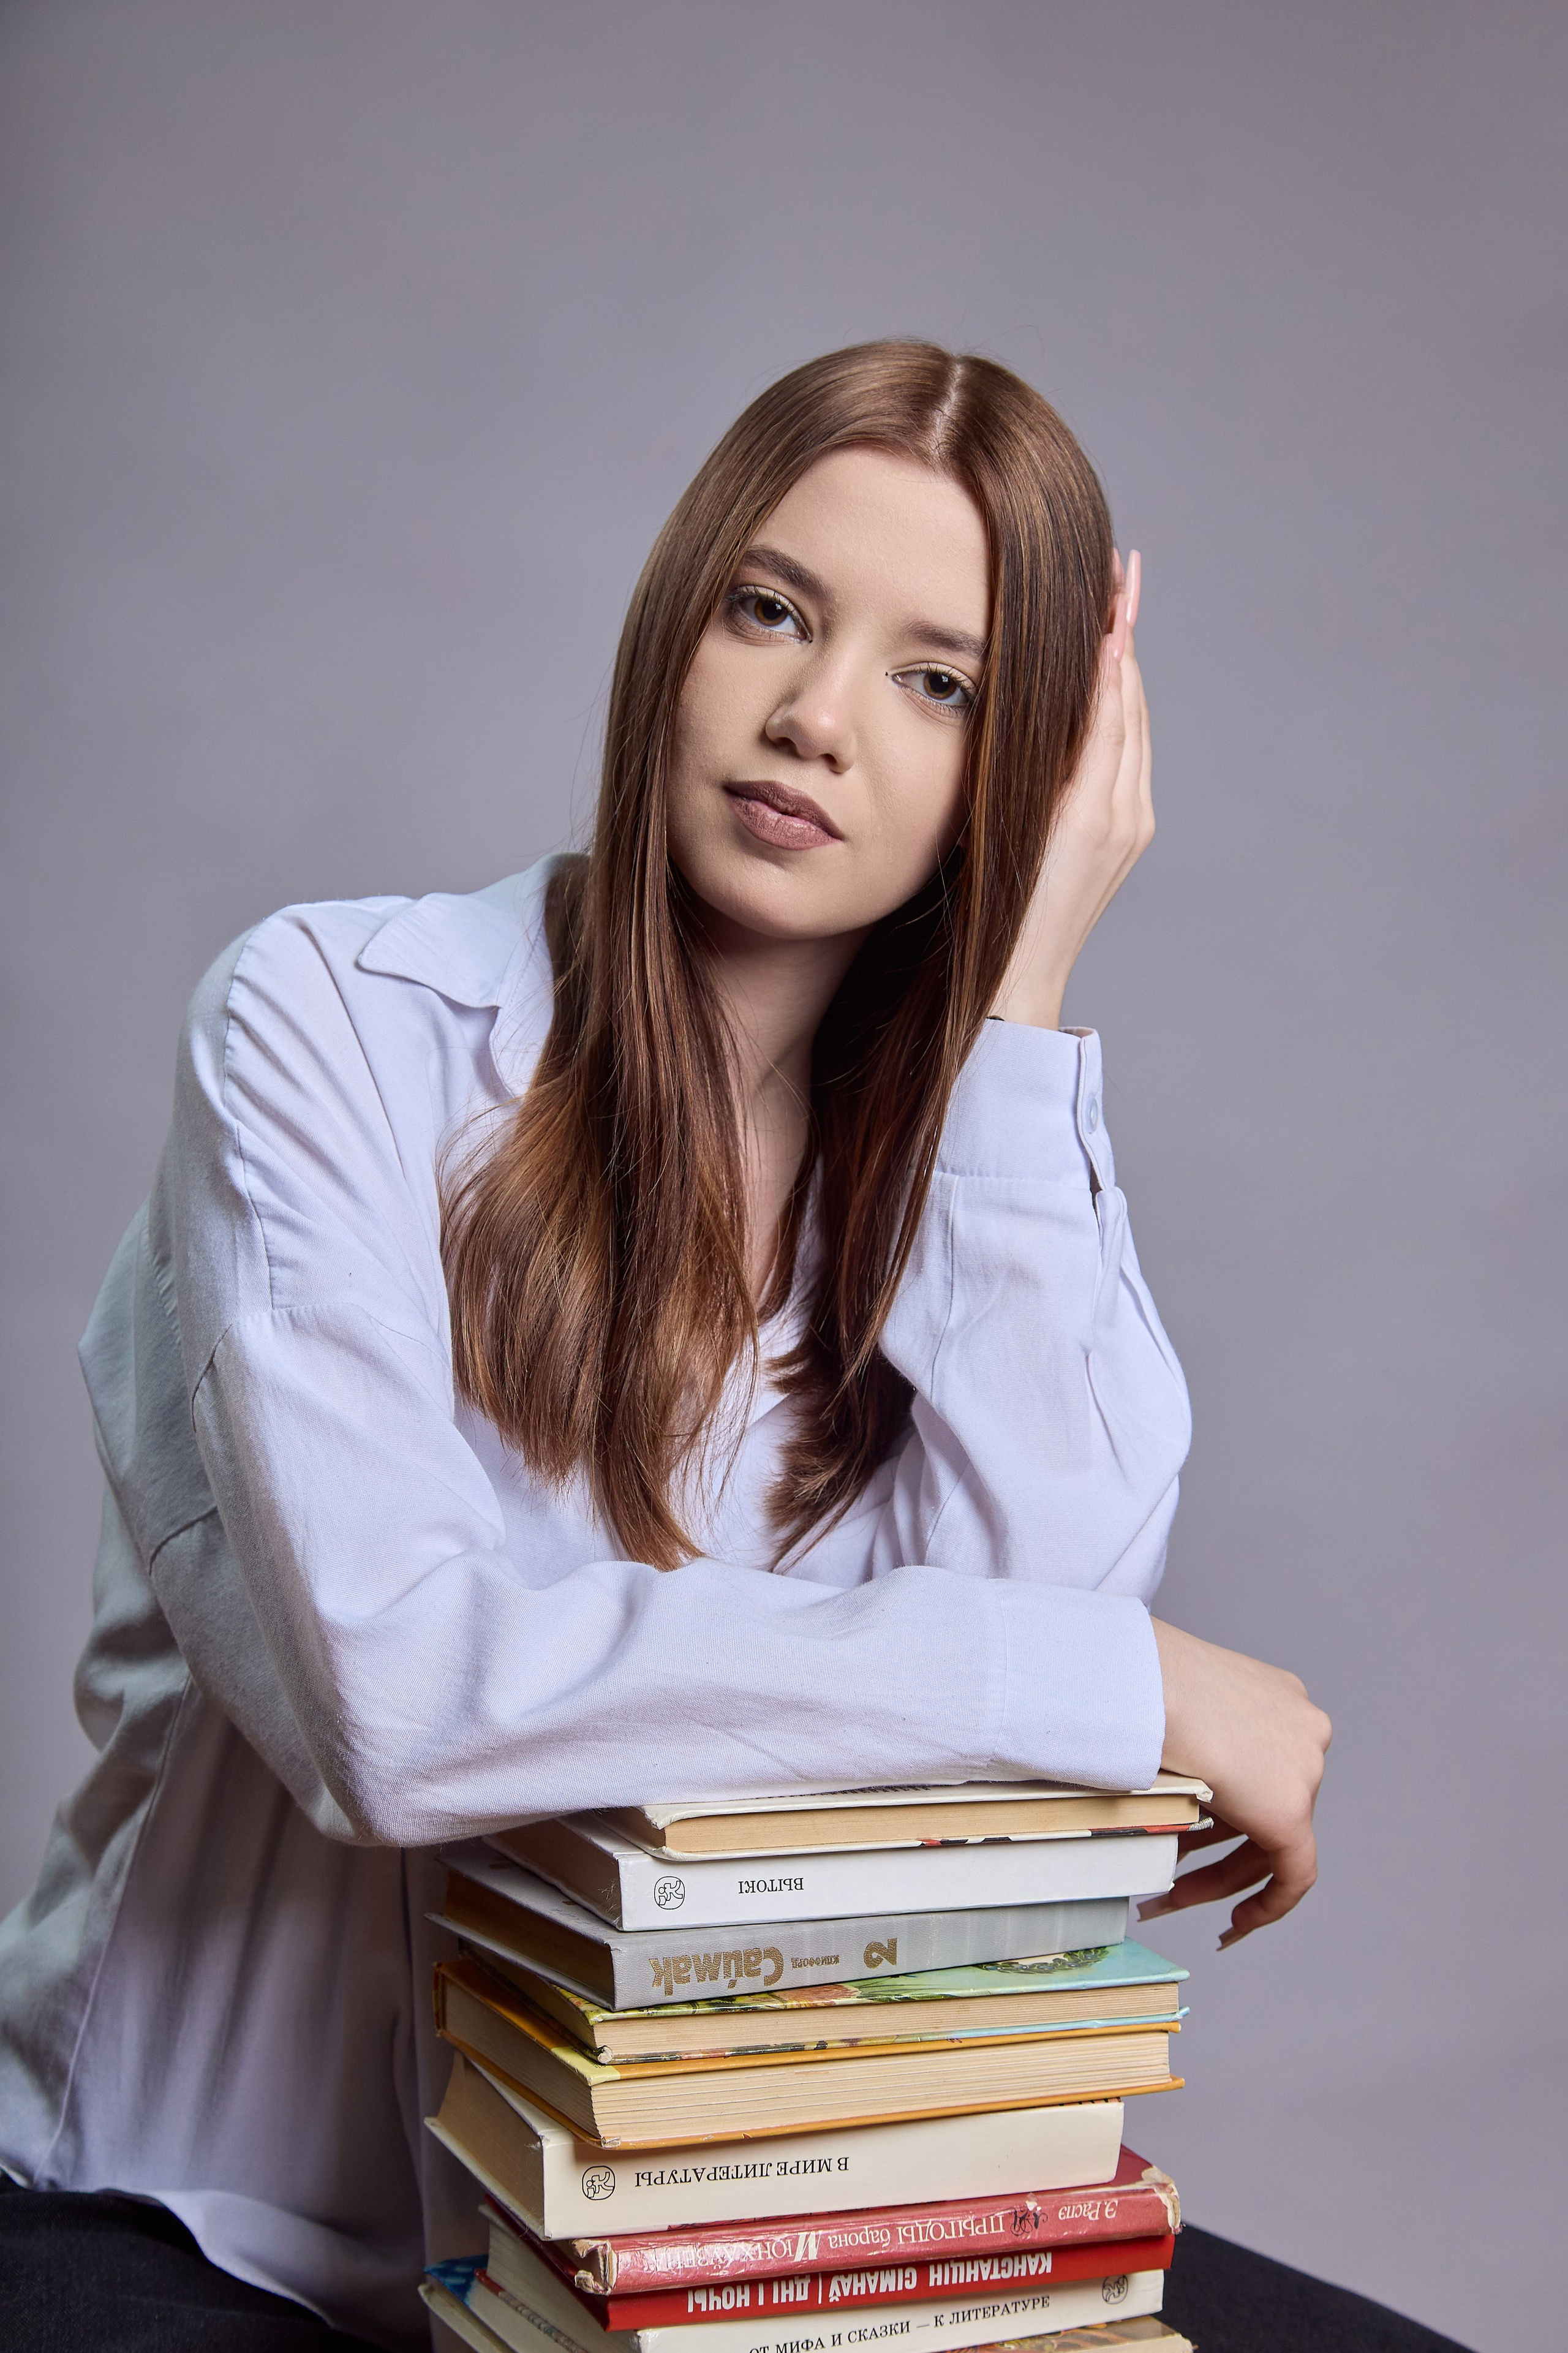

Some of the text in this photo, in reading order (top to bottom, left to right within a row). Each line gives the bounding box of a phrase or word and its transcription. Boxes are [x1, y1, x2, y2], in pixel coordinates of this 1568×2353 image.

[738, 1877, 804, 1894] ВЫТОКІ
[863, 1938, 897, 1969] 2
[649, 1947, 785, 1997] Саймак
[635, 2156, 850, 2187] В МИРЕ ЛИТЕРАТУРЫ
[829, 2226, 891, 2248] барона
[898, 2215, 1005, 2245] ПРЫГОДЫ
[829, 2267, 917, 2303] СІМАНАЎ
[929, 2252, 1052, 2287] КАНСТАНЦІН
[688, 2284, 750, 2313] НОЧЫ
[773, 2275, 812, 2304] ДНІ
[775, 2337, 826, 2353] МИФА
[831, 2333, 842, 2347] И
[848, 2321, 911, 2344] СКАЗКИ
[934, 2315, 944, 2328] К
[949, 2295, 1050, 2325] ЛИТЕРАТУРЕ
